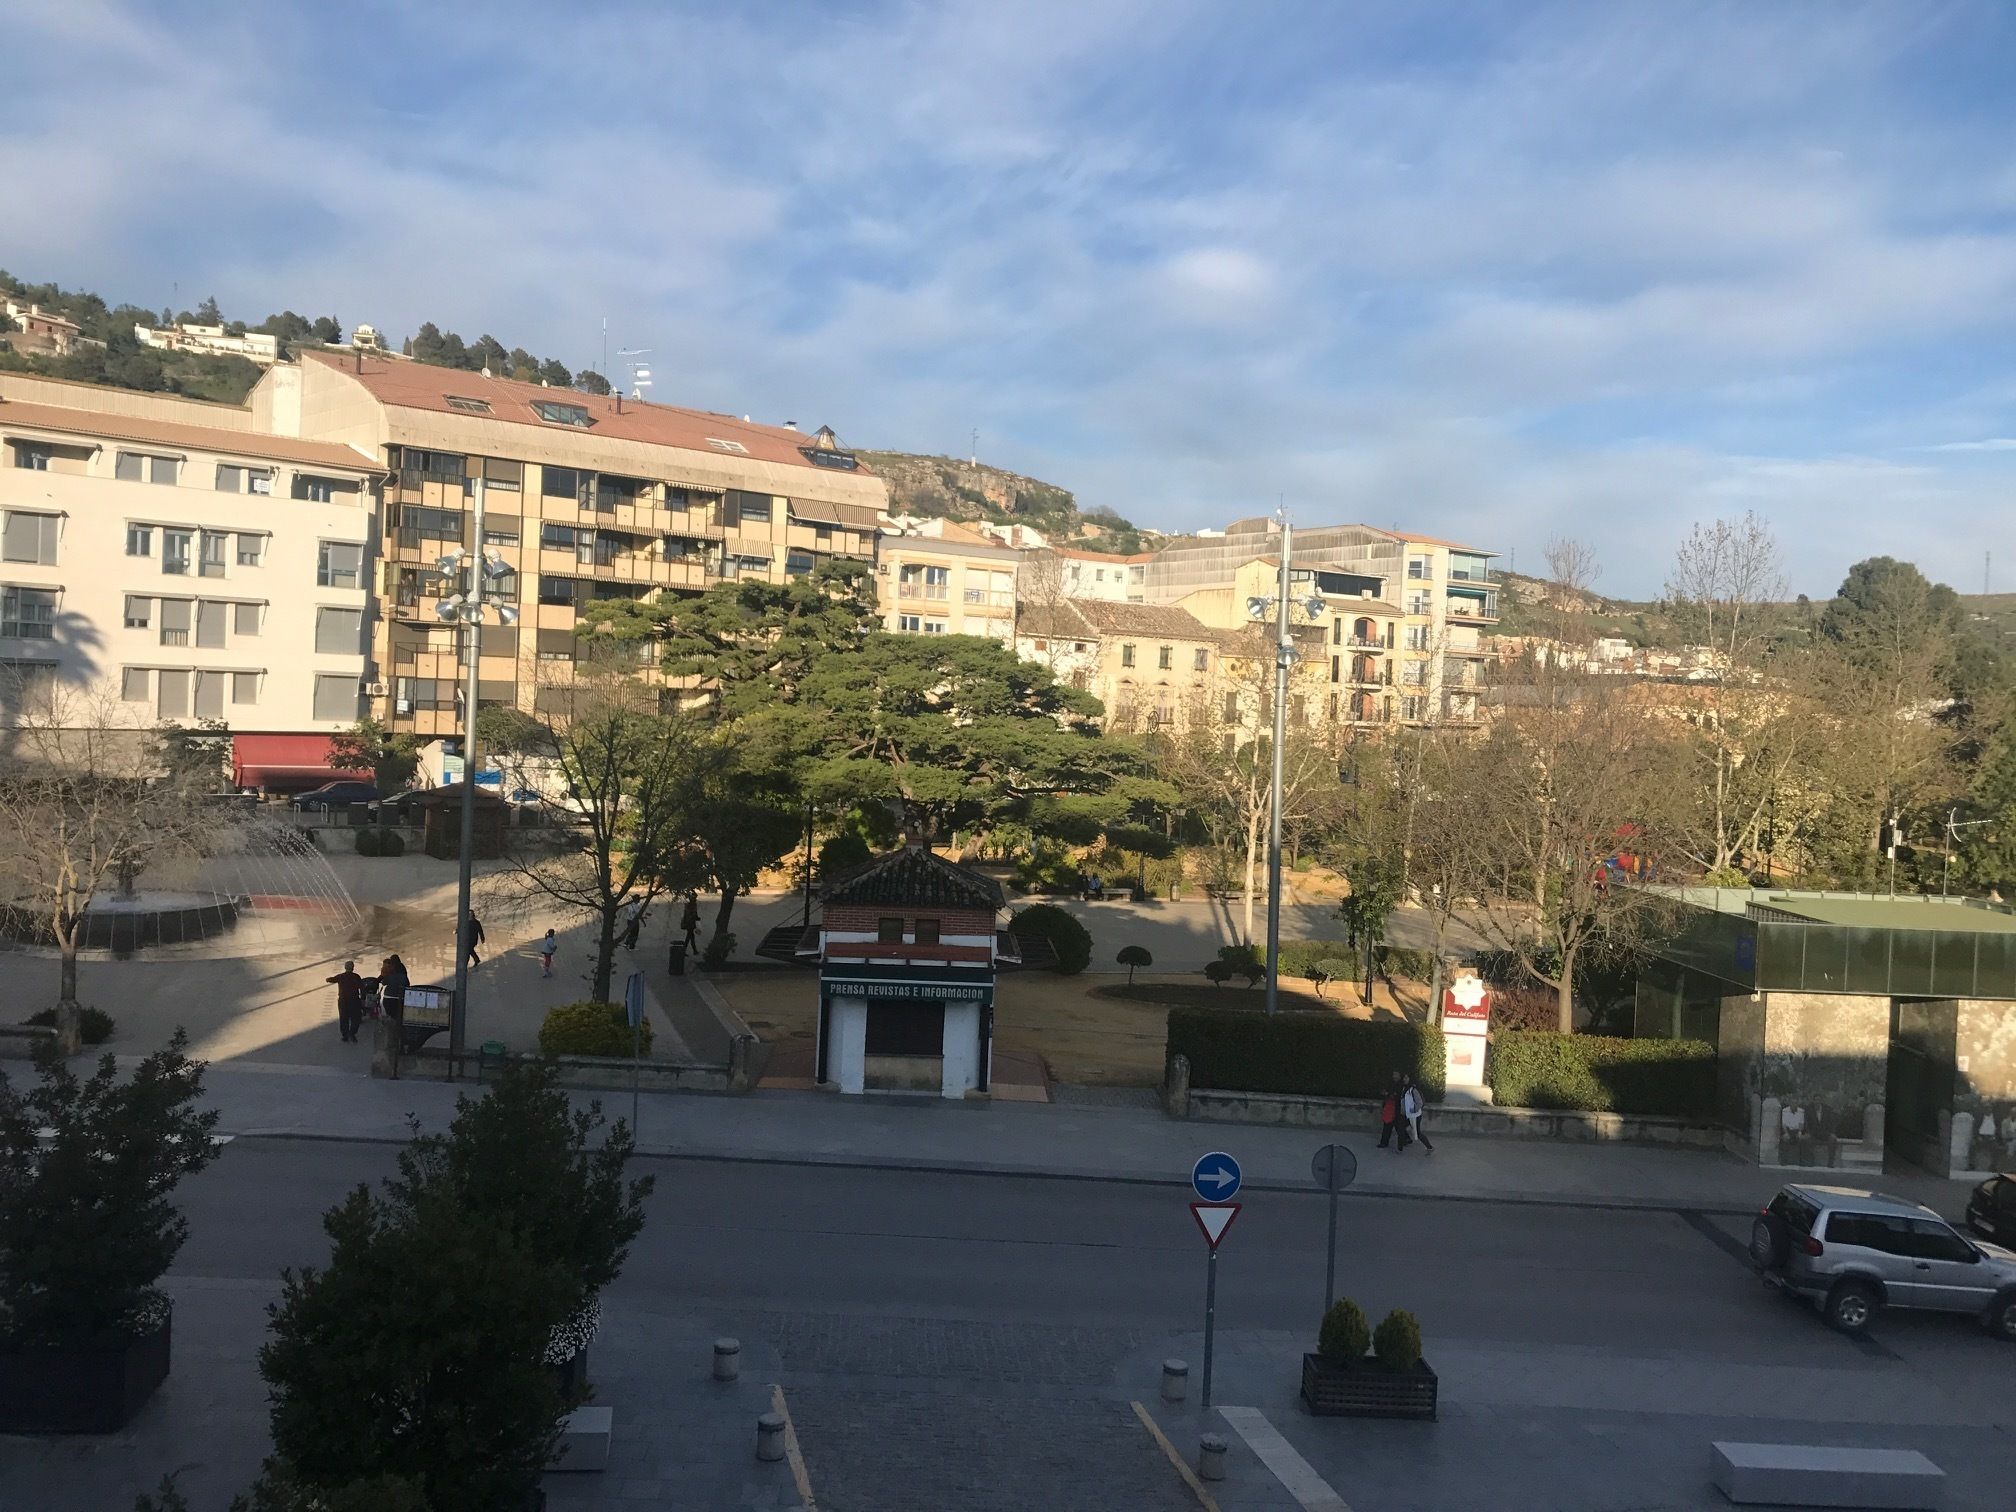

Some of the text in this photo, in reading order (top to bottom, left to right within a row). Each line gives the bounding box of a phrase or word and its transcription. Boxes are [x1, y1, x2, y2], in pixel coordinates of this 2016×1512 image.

[830, 983, 984, 999] PRENSA REVISTAS E INFORMACION
